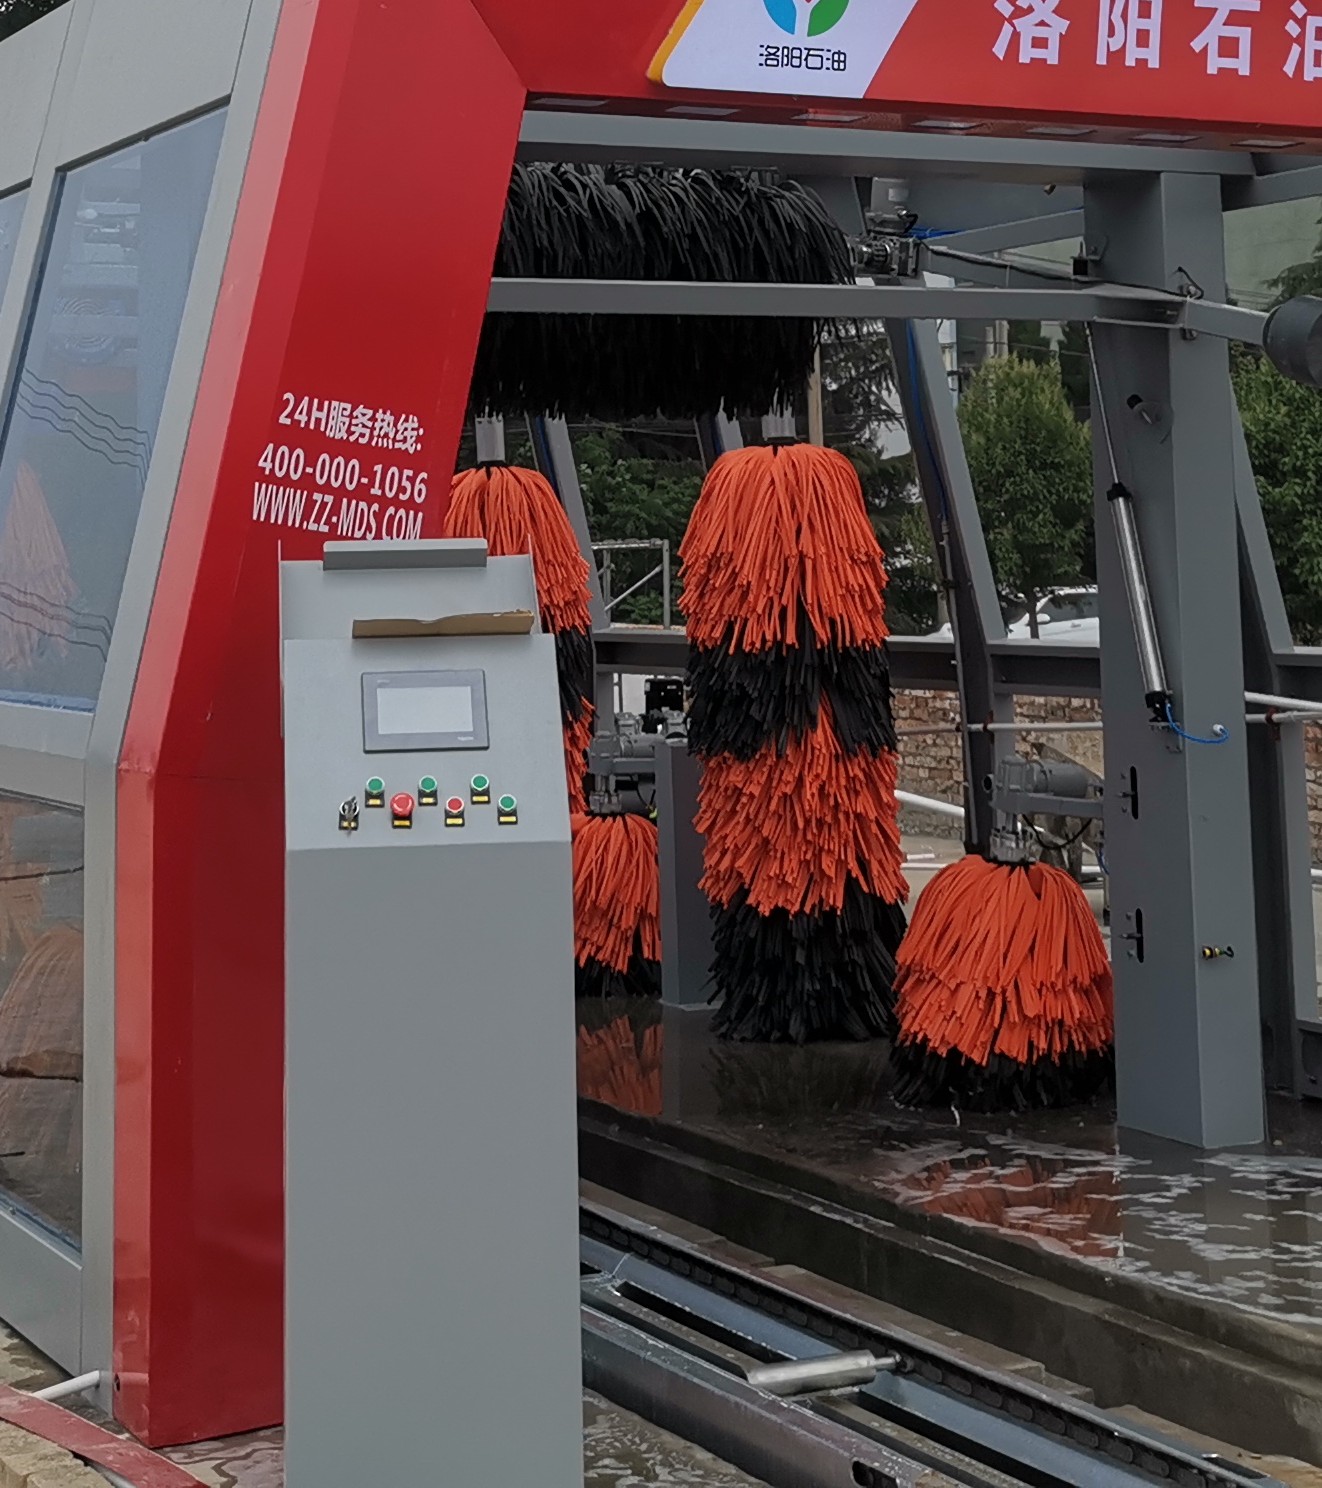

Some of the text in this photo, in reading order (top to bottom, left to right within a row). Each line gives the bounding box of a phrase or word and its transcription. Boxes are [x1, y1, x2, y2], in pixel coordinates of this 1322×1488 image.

[758, 44, 847, 71] 洛阳石油
[258, 443, 428, 503] 400-000-1056
[252, 481, 424, 541] WWW.ZZ-MDSCOM
